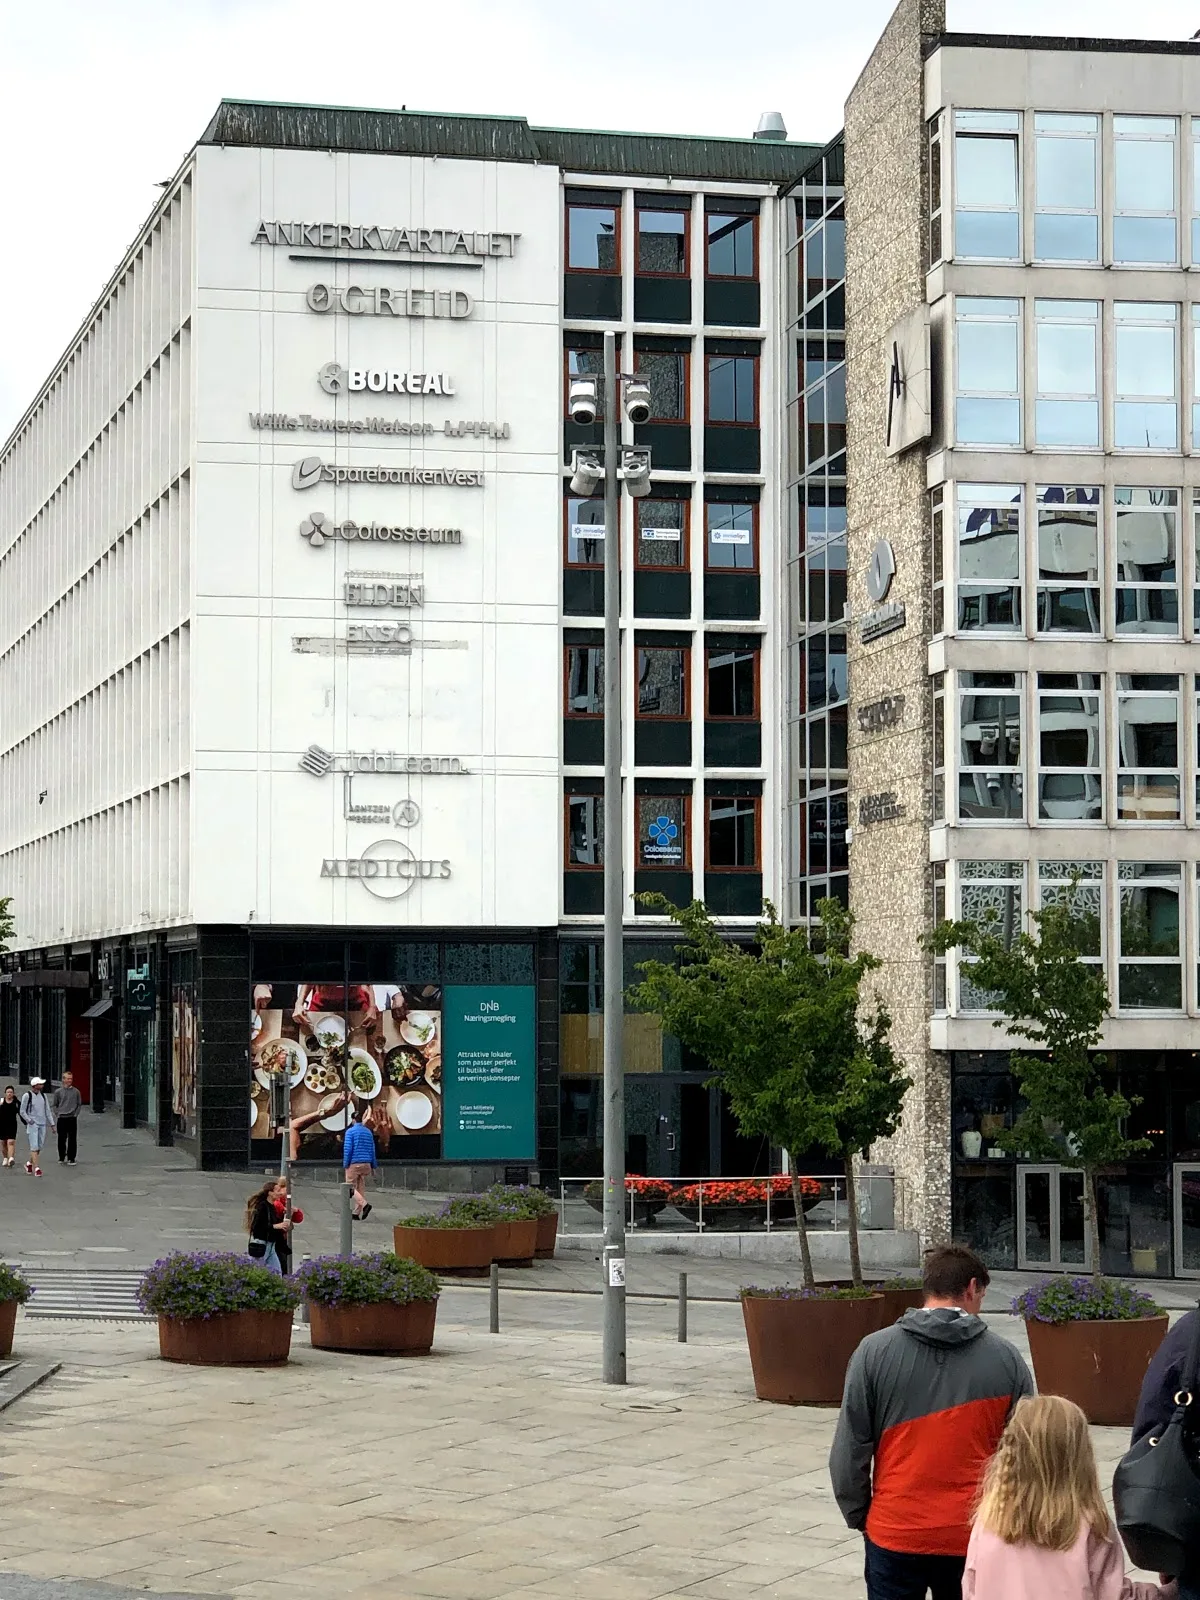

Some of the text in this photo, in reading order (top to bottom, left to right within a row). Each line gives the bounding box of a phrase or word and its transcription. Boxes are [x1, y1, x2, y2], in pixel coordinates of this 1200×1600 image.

[251, 219, 522, 258] ANKERKVARTALET
[307, 282, 475, 319] ØGREID
[347, 368, 457, 396] BOREAL
[249, 412, 434, 436] Willis Towers Watson
[340, 520, 464, 545] Colosseum
[344, 583, 425, 608] ELDEN
[643, 844, 682, 853] Colosseum
[320, 858, 452, 880] MEDICUS
[480, 1000, 500, 1014] DNB
[464, 1014, 517, 1024] Næringsmegling
[457, 1066, 465, 1074] til
[466, 1066, 489, 1074] butikk-
[494, 1059, 517, 1067] perfekt
